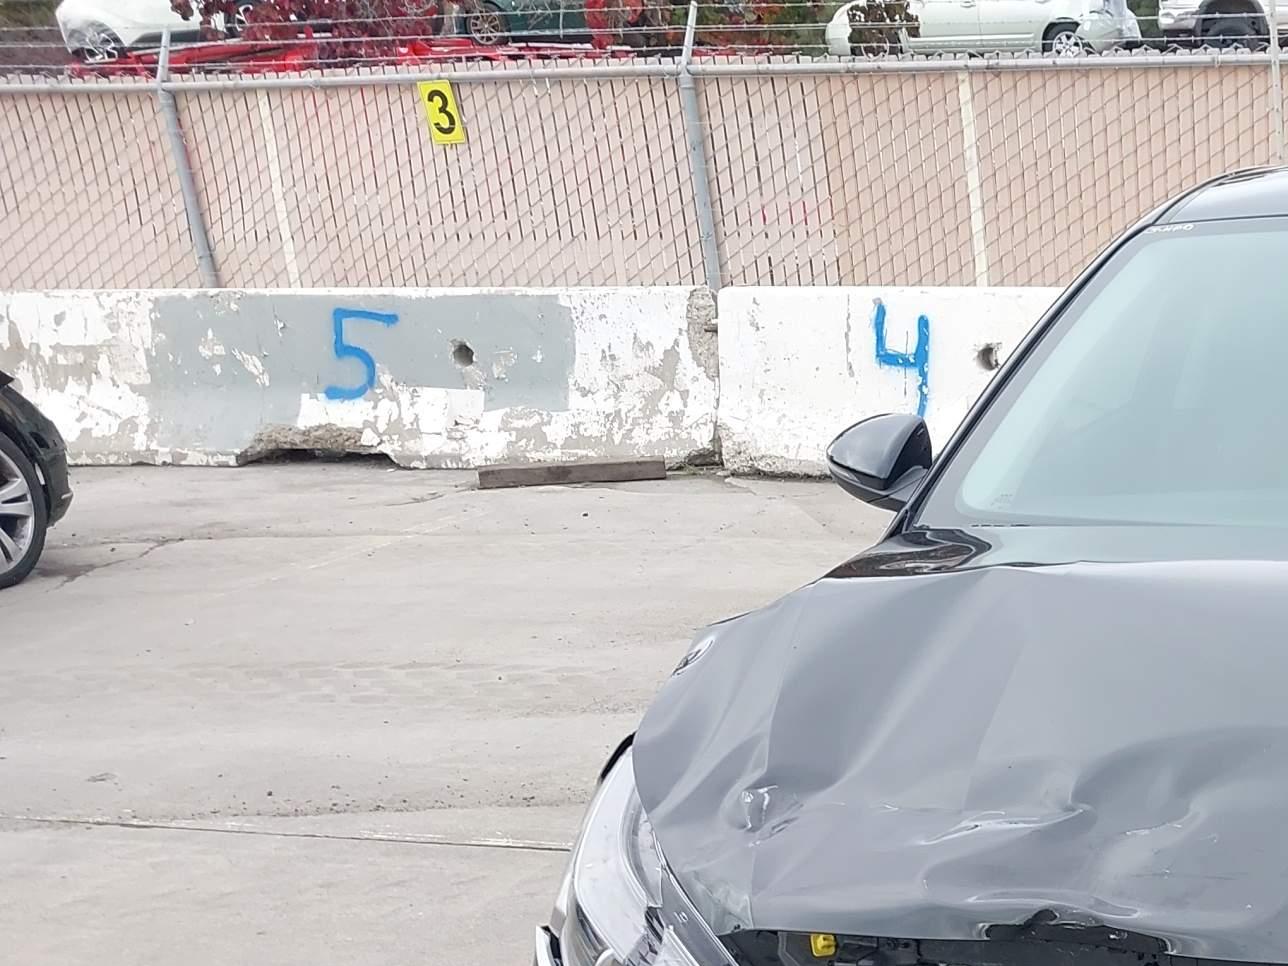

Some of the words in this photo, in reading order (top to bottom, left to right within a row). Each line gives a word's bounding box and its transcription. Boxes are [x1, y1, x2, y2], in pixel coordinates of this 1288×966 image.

[427, 89, 456, 135] 3
[325, 307, 399, 400] 5
[874, 300, 929, 418] 4
